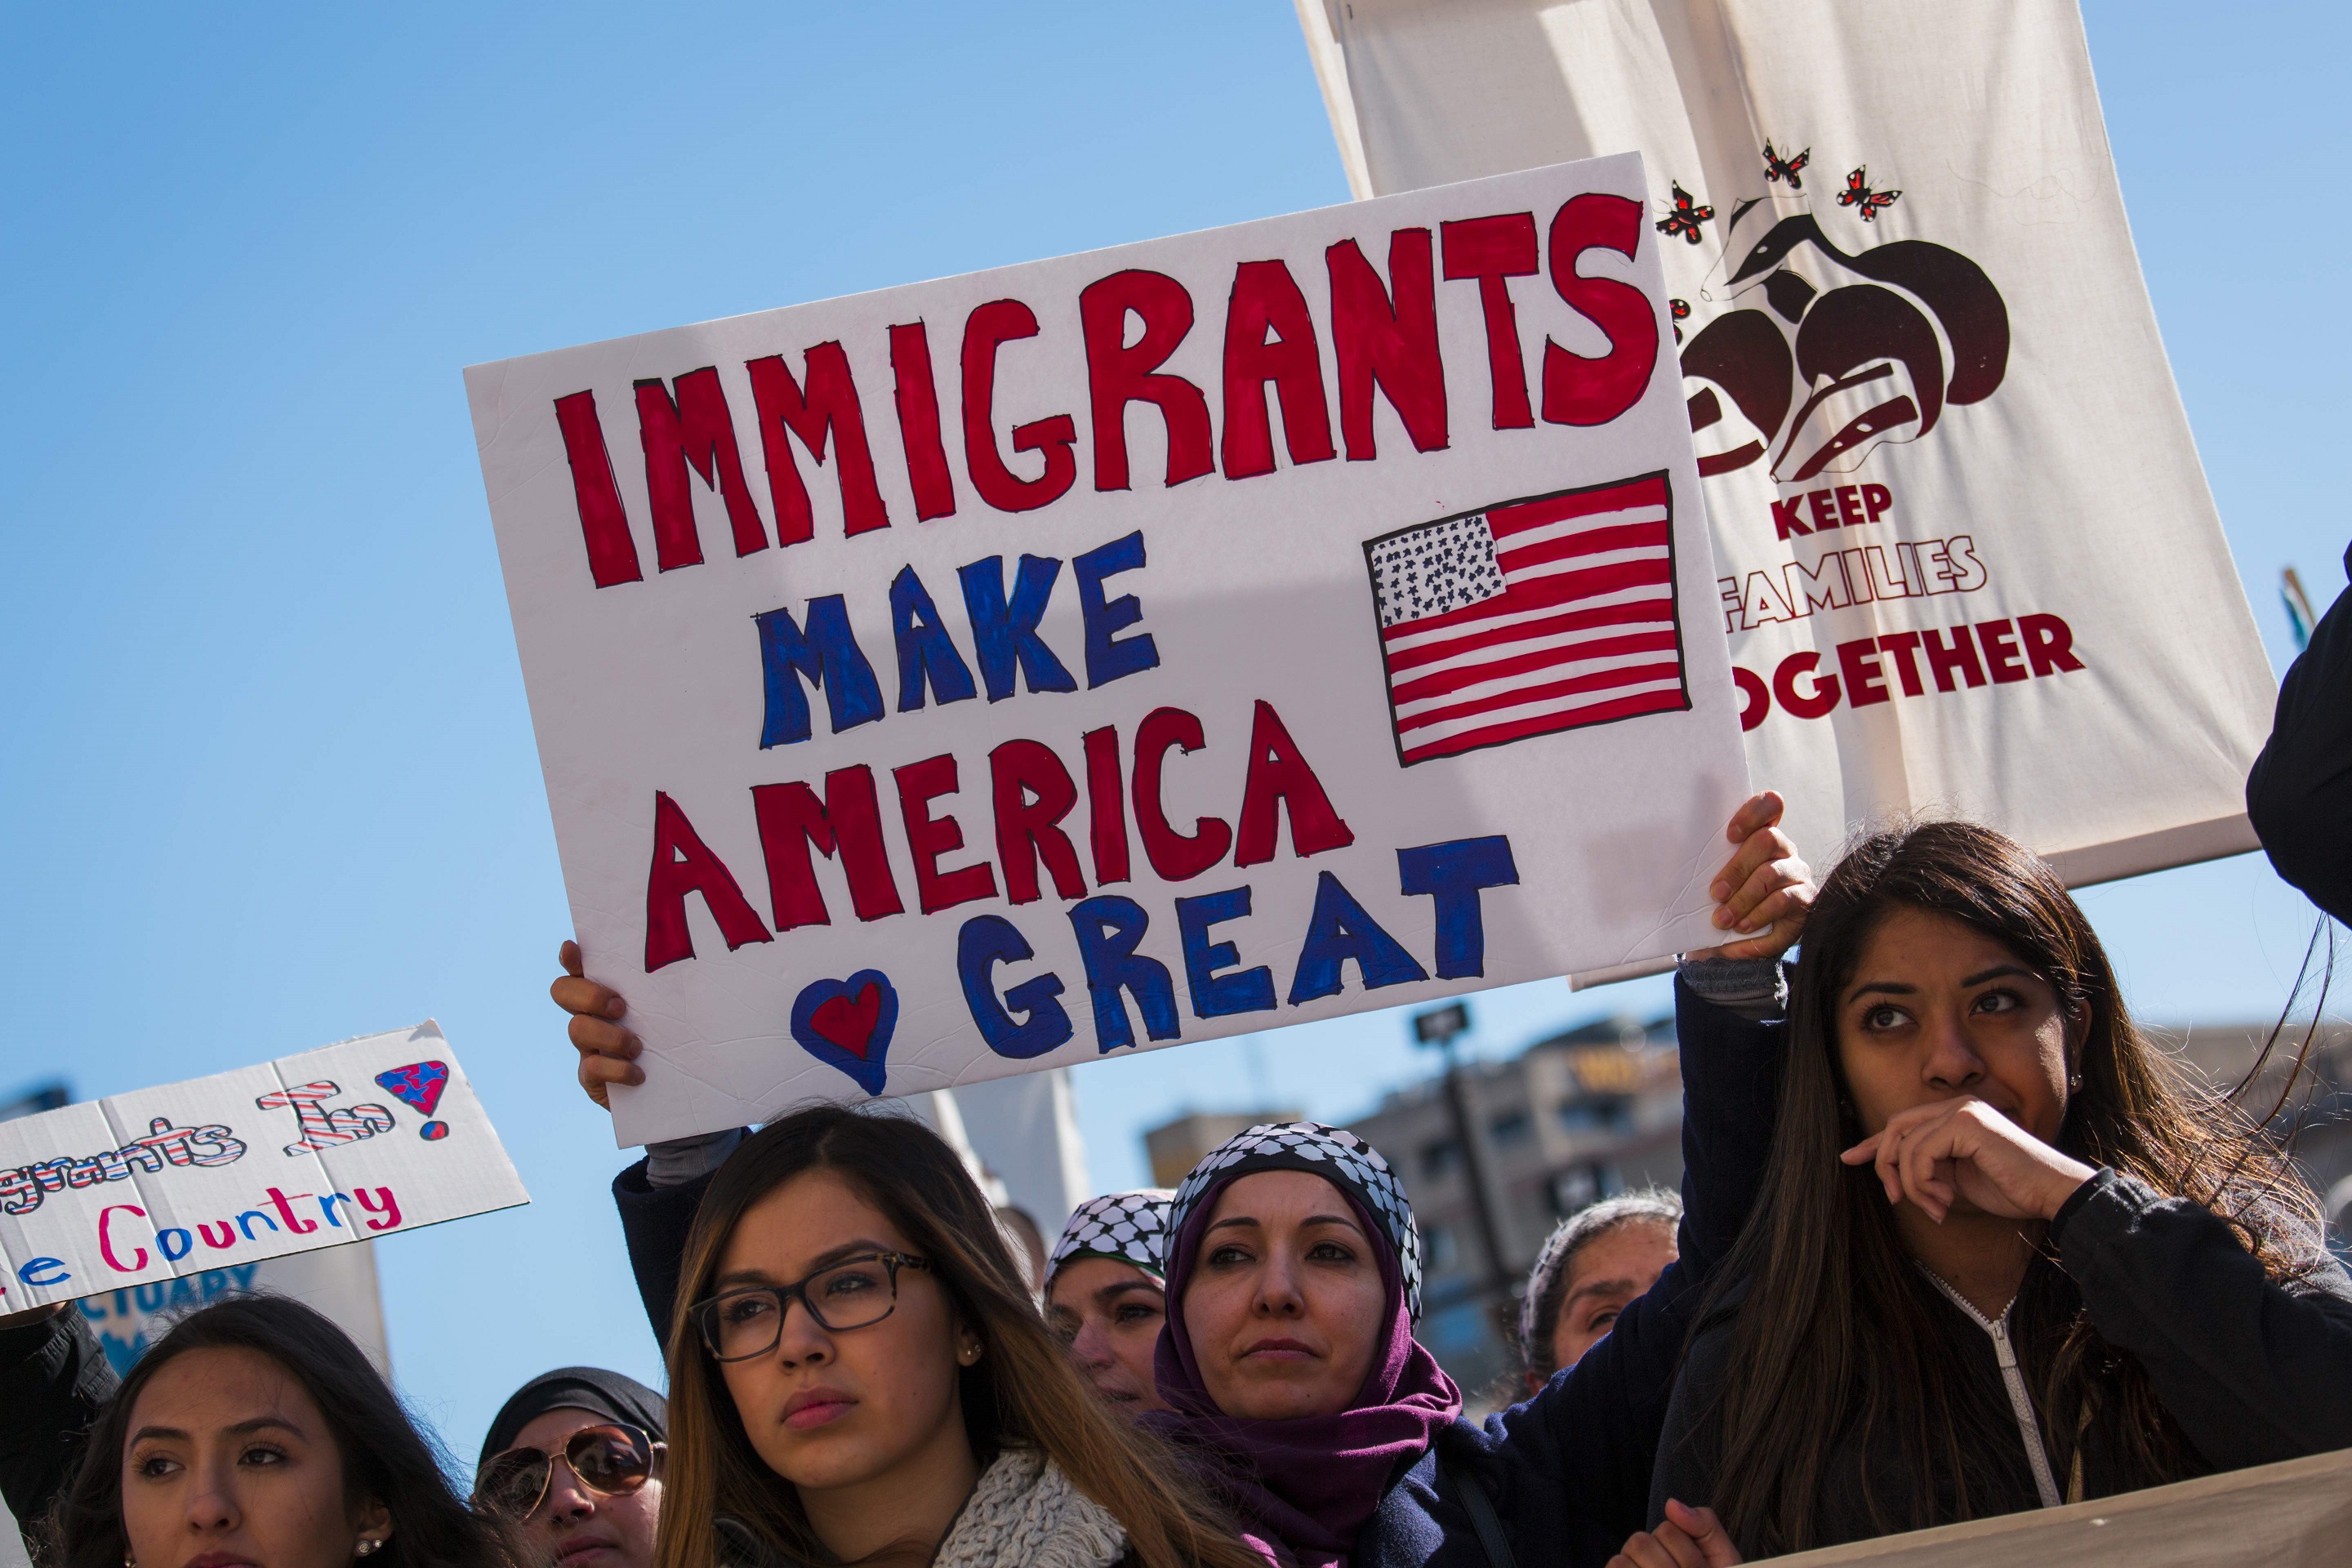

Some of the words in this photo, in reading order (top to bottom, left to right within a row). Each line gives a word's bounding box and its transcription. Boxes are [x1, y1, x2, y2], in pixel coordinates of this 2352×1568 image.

[554, 193, 1659, 589] IMMIGRANTS
[1770, 483, 1893, 541] KEEP
[751, 530, 1160, 751] MAKE
[1732, 612, 2087, 733] OGETHER
[645, 699, 1355, 973] AMERICA
[957, 835, 1520, 1058] GREAT
[0, 1117, 247, 1214] grants
[99, 1187, 402, 1272] Country
